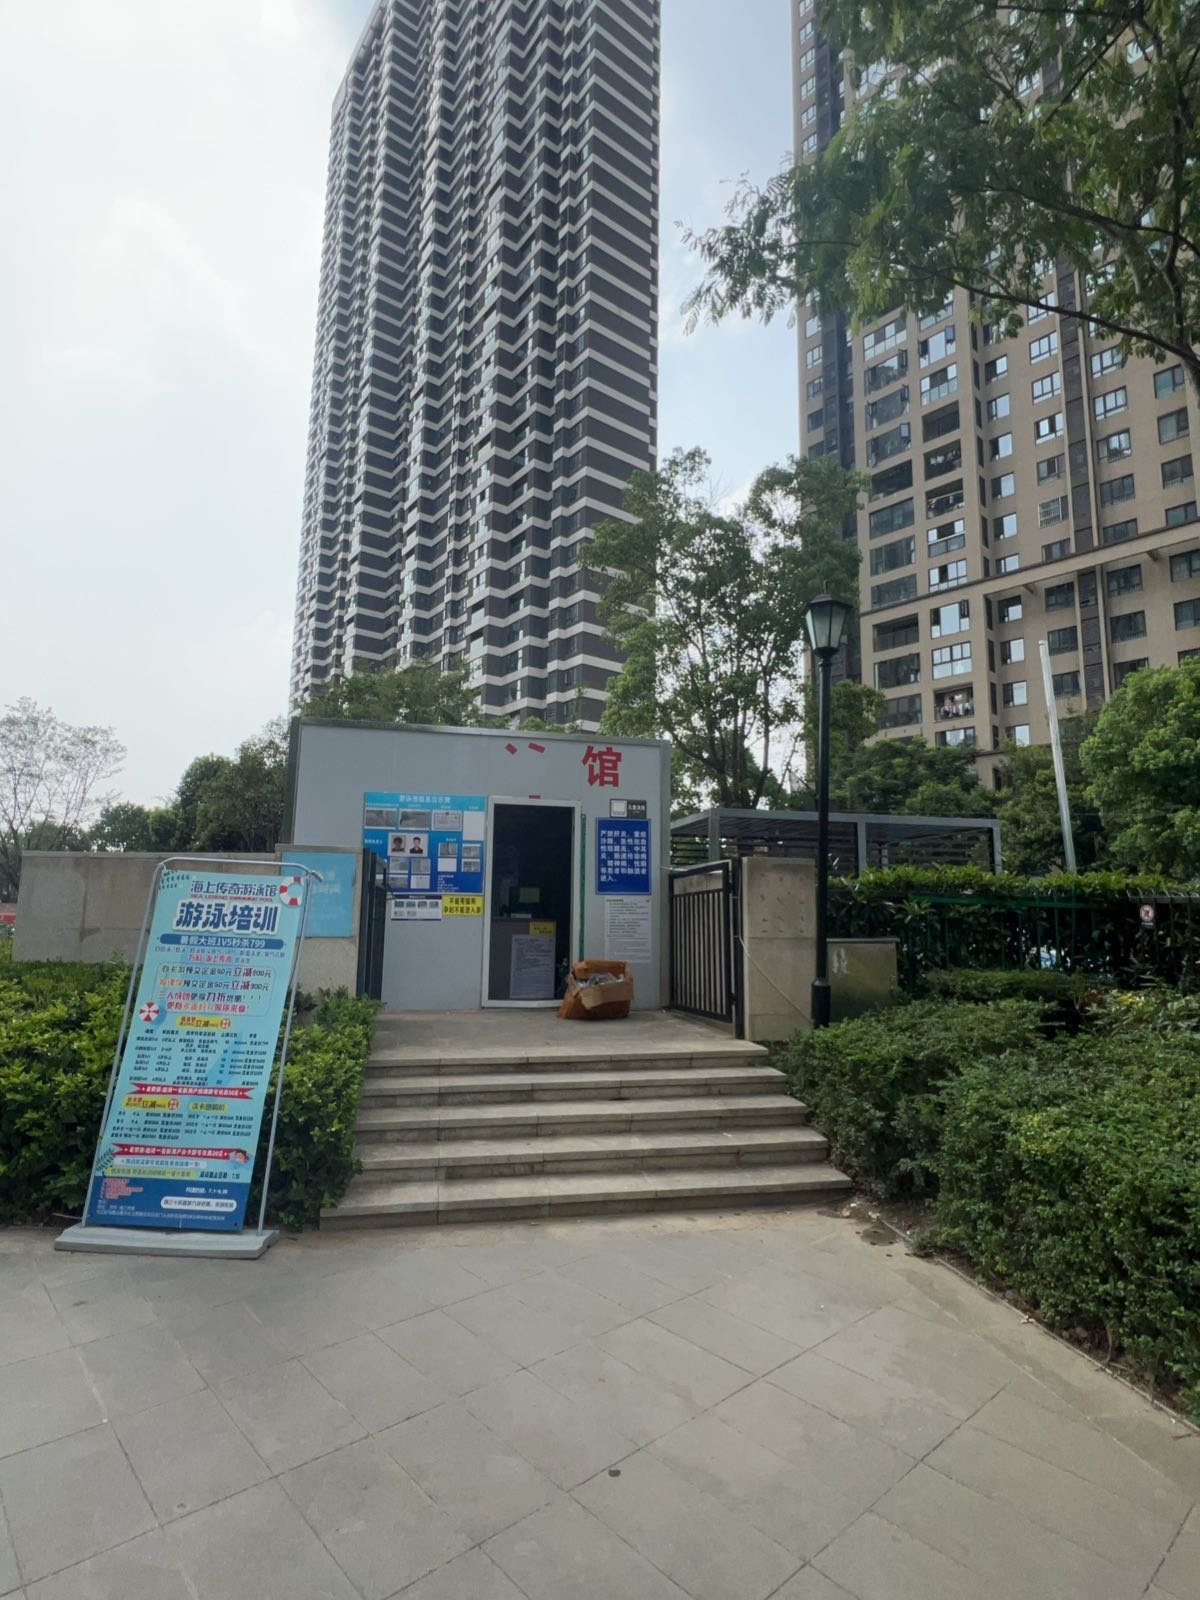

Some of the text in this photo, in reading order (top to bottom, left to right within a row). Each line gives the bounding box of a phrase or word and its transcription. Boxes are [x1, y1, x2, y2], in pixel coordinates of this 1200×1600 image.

[582, 745, 621, 787] 馆
[190, 880, 277, 897] 海上传奇游泳馆
[176, 902, 279, 932] 游泳培训
